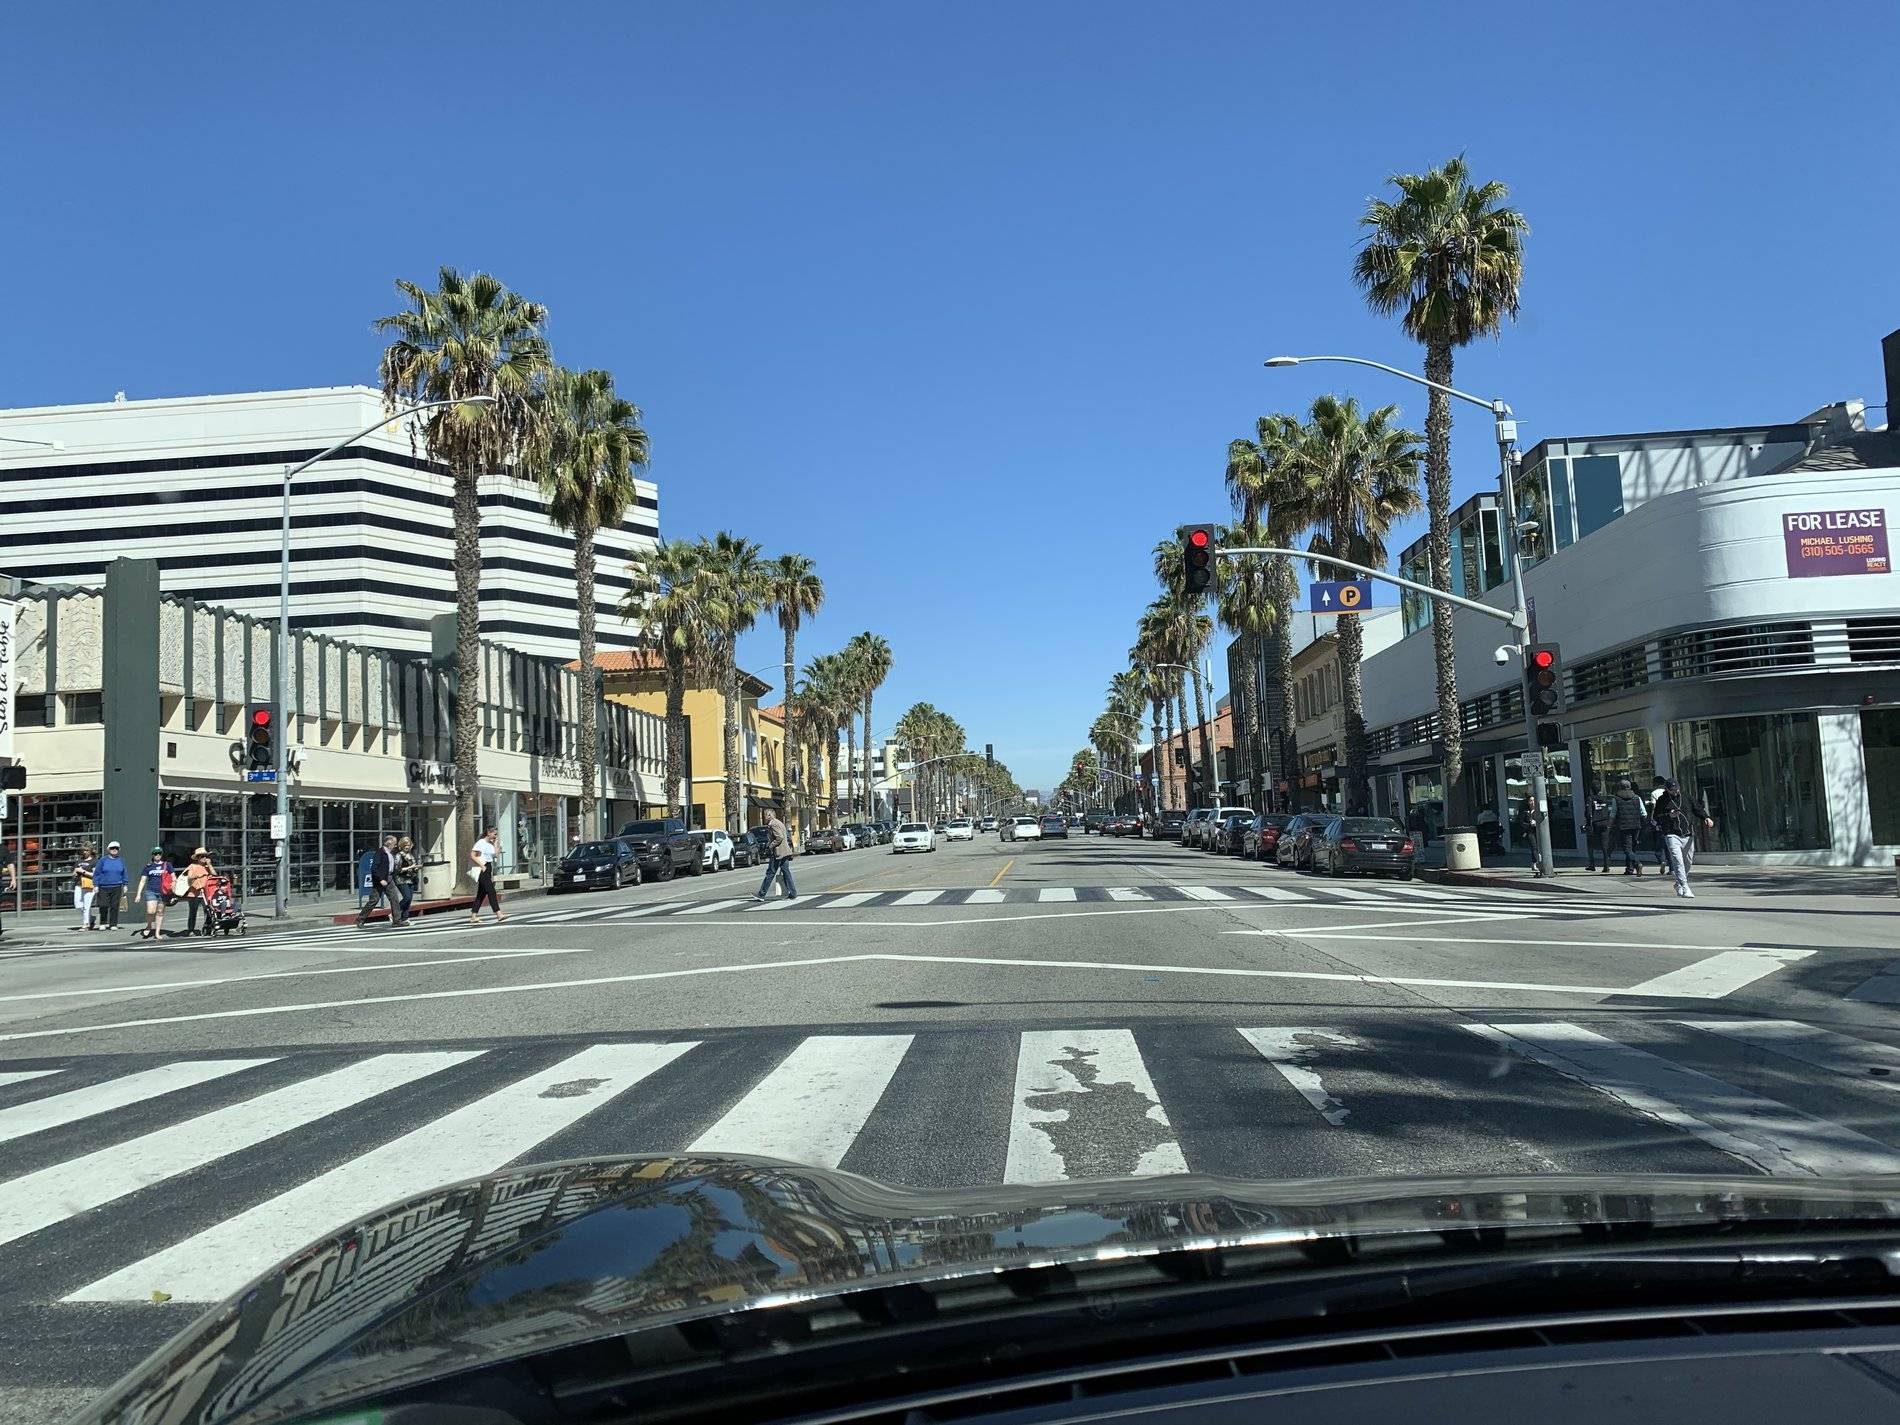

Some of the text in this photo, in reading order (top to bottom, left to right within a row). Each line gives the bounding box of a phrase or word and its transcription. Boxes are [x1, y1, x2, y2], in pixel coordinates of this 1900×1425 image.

[1788, 511, 1882, 531] FOR LEASE
[1800, 535, 1874, 546] MICHAEL LUSHING
[1801, 544, 1875, 558] (310) 505-0565
[1347, 590, 1356, 602] P
